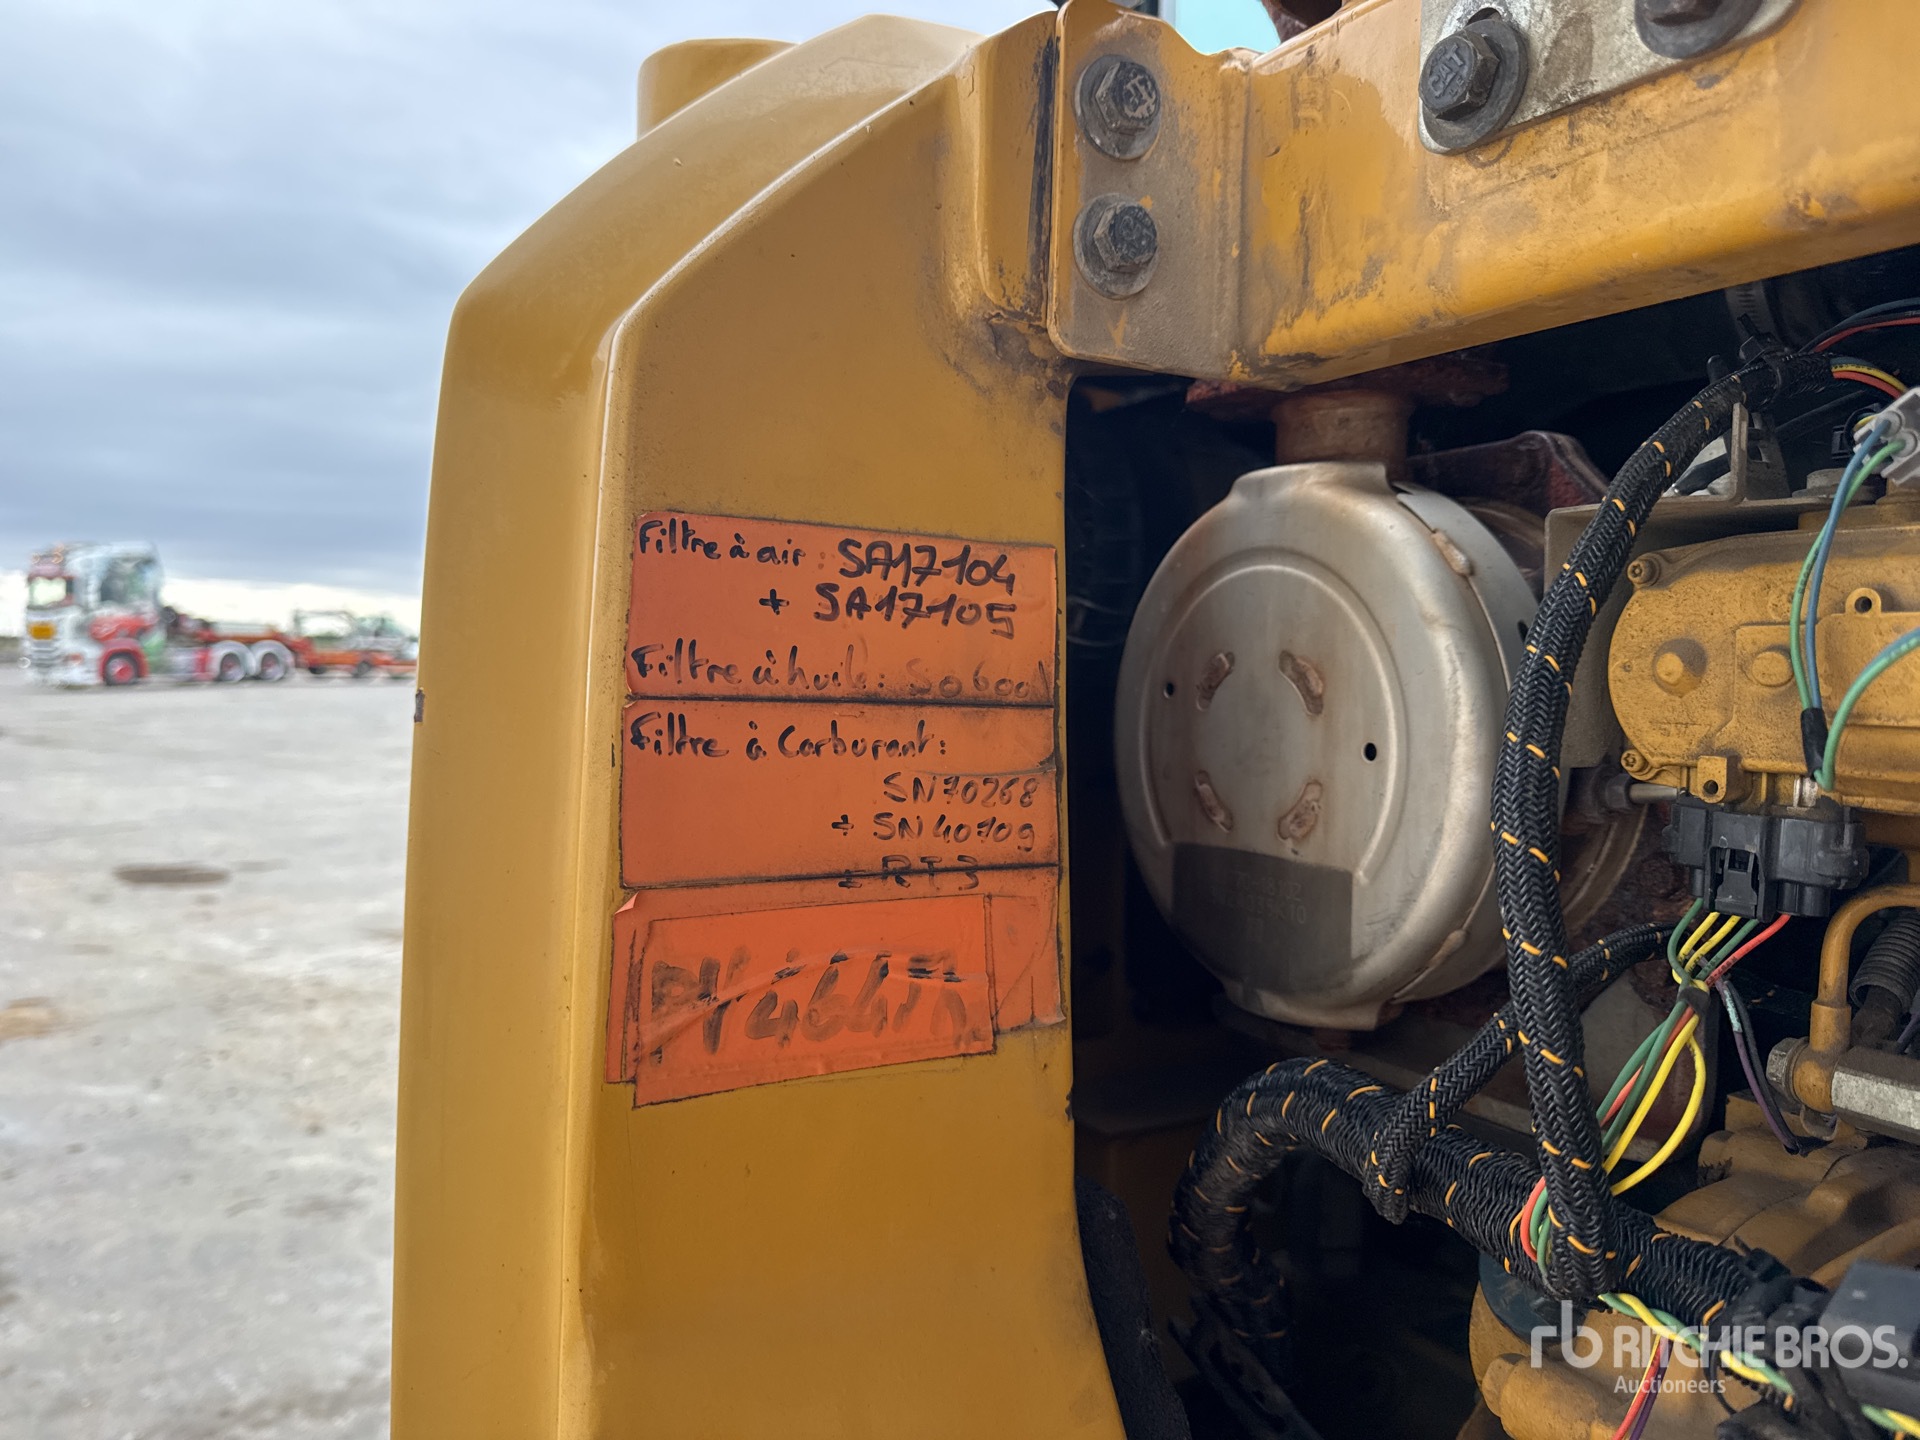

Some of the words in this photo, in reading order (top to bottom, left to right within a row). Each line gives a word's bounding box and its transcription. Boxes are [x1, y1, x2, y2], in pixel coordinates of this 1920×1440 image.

[639, 517, 722, 560] Filtre
[729, 532, 750, 559] à
[837, 537, 1017, 596] SA17104
[813, 581, 1017, 640] SA17105
[630, 637, 743, 685] Filtre
[752, 649, 781, 686] à
[630, 710, 730, 757] Filtre
[745, 719, 768, 762] à
[883, 771, 1041, 809] SN70268
